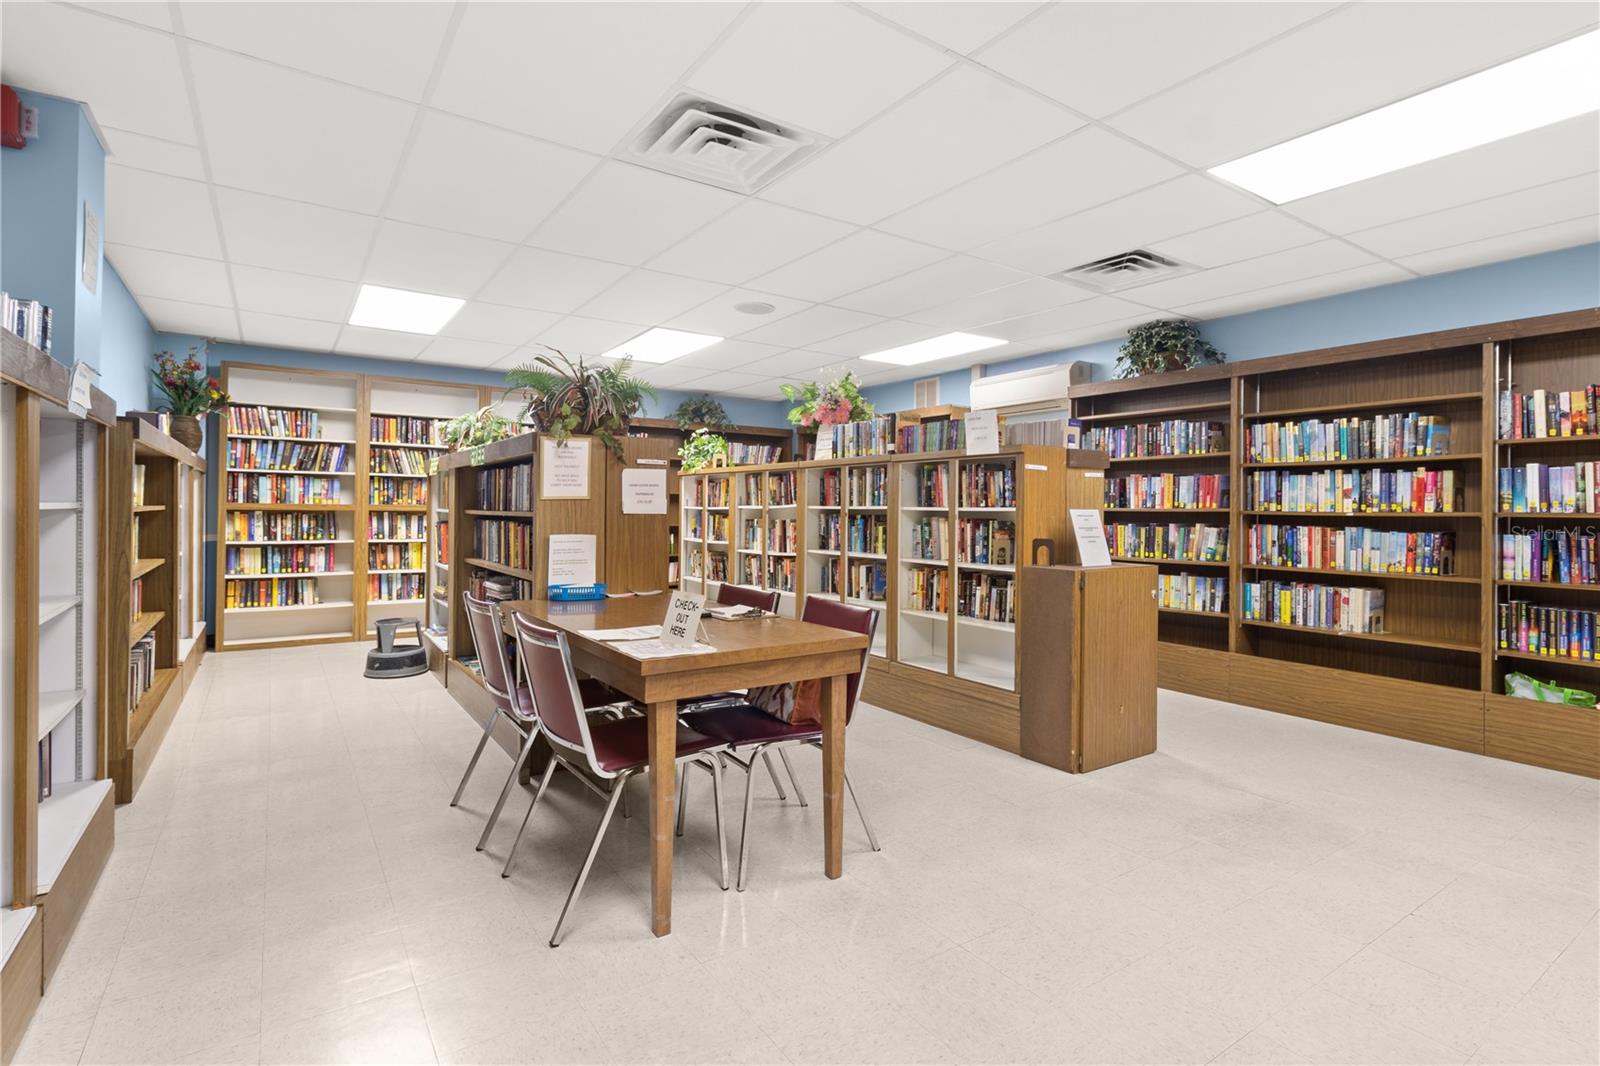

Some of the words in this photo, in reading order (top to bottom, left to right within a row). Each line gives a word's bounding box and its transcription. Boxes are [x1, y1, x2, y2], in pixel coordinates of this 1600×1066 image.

[675, 598, 700, 611] CHECK-
[676, 613, 689, 624] OUT
[670, 625, 686, 638] HERE
